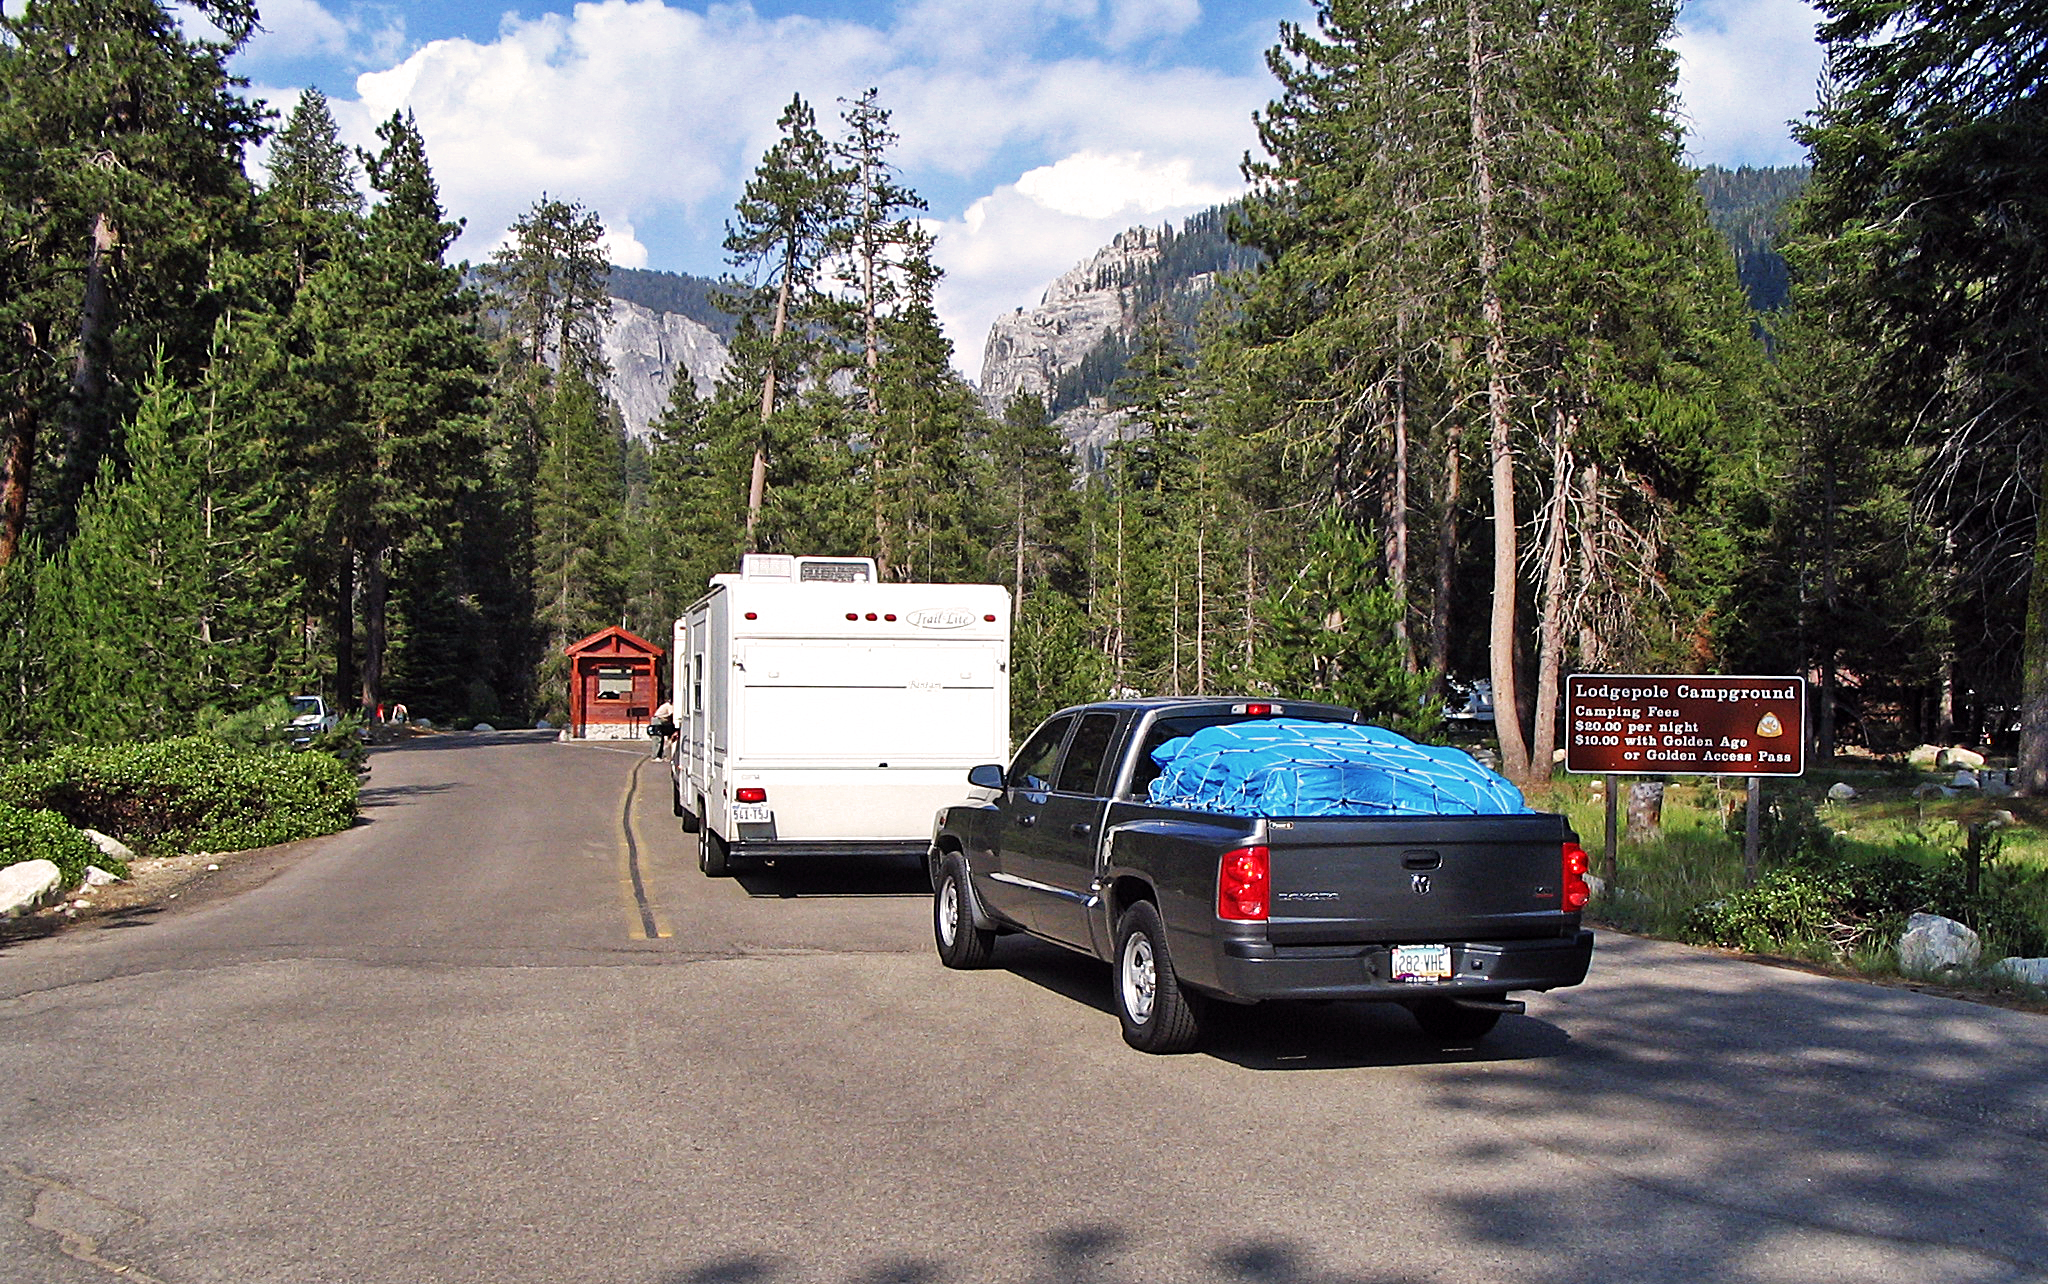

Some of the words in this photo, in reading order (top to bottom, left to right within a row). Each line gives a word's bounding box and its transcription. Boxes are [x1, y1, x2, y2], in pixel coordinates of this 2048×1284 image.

[1575, 684, 1669, 701] Lodgepole
[1677, 685, 1795, 702] Campground
[1575, 705, 1641, 719] Camping
[1647, 705, 1680, 717] Fees
[1575, 720, 1622, 732] $20.00
[1627, 722, 1652, 735] per
[1658, 721, 1699, 735] night
[1575, 734, 1619, 746] $10.00
[1624, 735, 1657, 746] with
[1663, 735, 1713, 747] Golden
[1719, 735, 1748, 750] Age
[1623, 751, 1641, 760] or
[1646, 749, 1697, 761] Golden
[1702, 750, 1752, 762] Access
[1758, 751, 1792, 762] Pass
